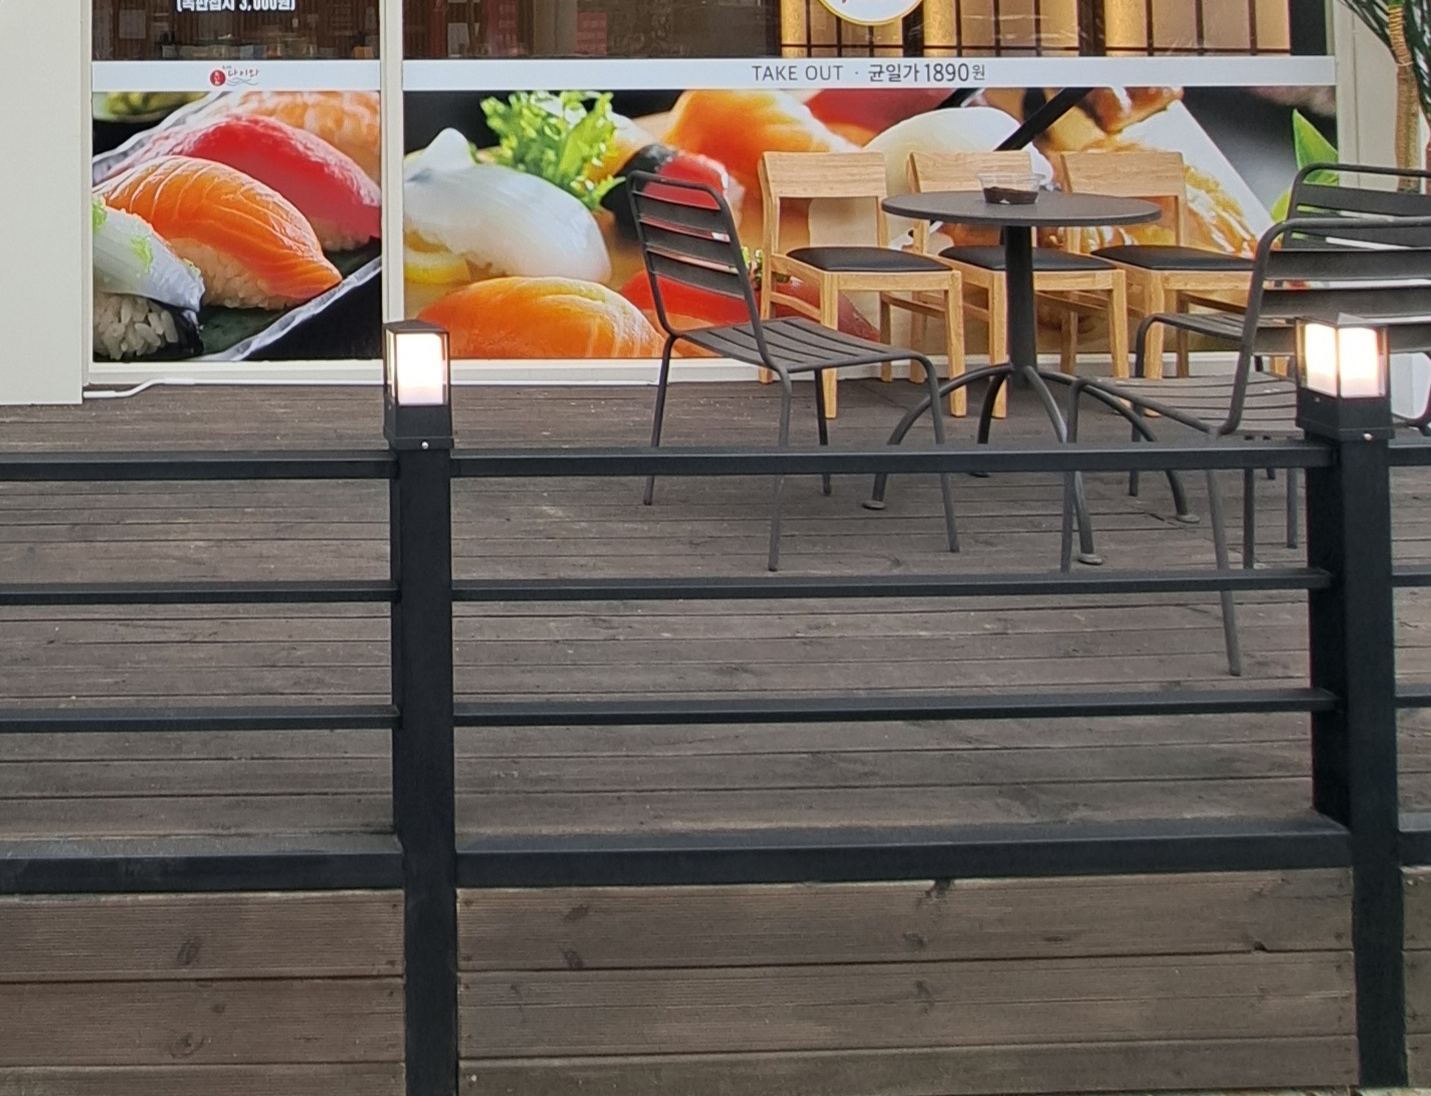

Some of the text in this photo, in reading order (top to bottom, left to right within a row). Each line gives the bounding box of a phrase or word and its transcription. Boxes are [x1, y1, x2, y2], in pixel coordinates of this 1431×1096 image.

[751, 62, 987, 83] TAKE OUT 균일가 1890원
